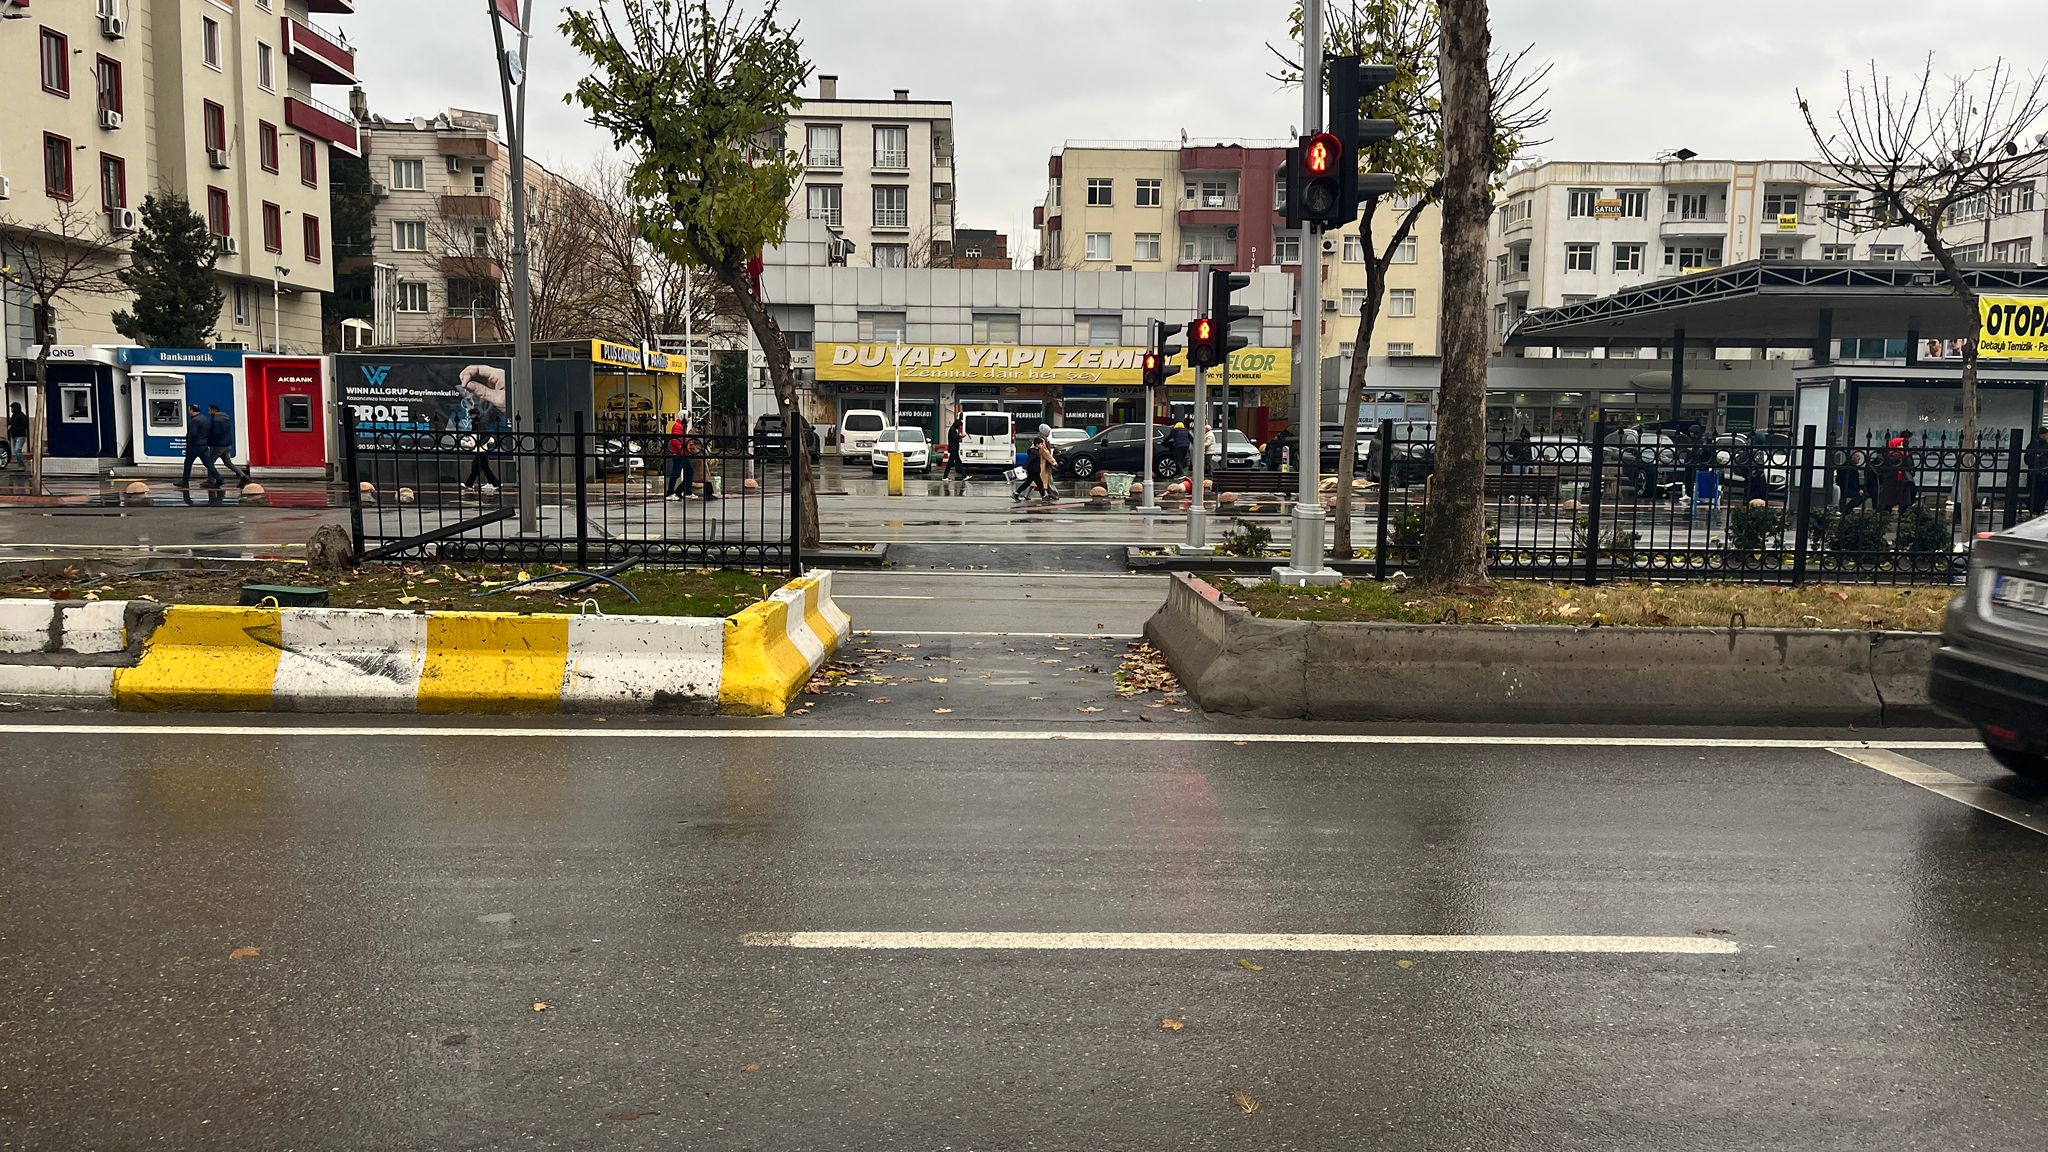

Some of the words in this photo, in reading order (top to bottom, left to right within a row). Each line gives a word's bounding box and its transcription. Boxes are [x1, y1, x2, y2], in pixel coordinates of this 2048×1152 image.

[52, 349, 75, 358] QNB
[160, 352, 213, 362] Bankamatik
[833, 345, 957, 368] DUYAP
[966, 348, 1046, 368] YAPI
[904, 366, 978, 379] Zemine
[983, 367, 1023, 380] dair
[1028, 368, 1065, 380] her
[1066, 371, 1103, 382] şey
[346, 387, 369, 395] WINN
[385, 388, 408, 396] GRUP
[409, 389, 451, 397] Gayrimenkul
